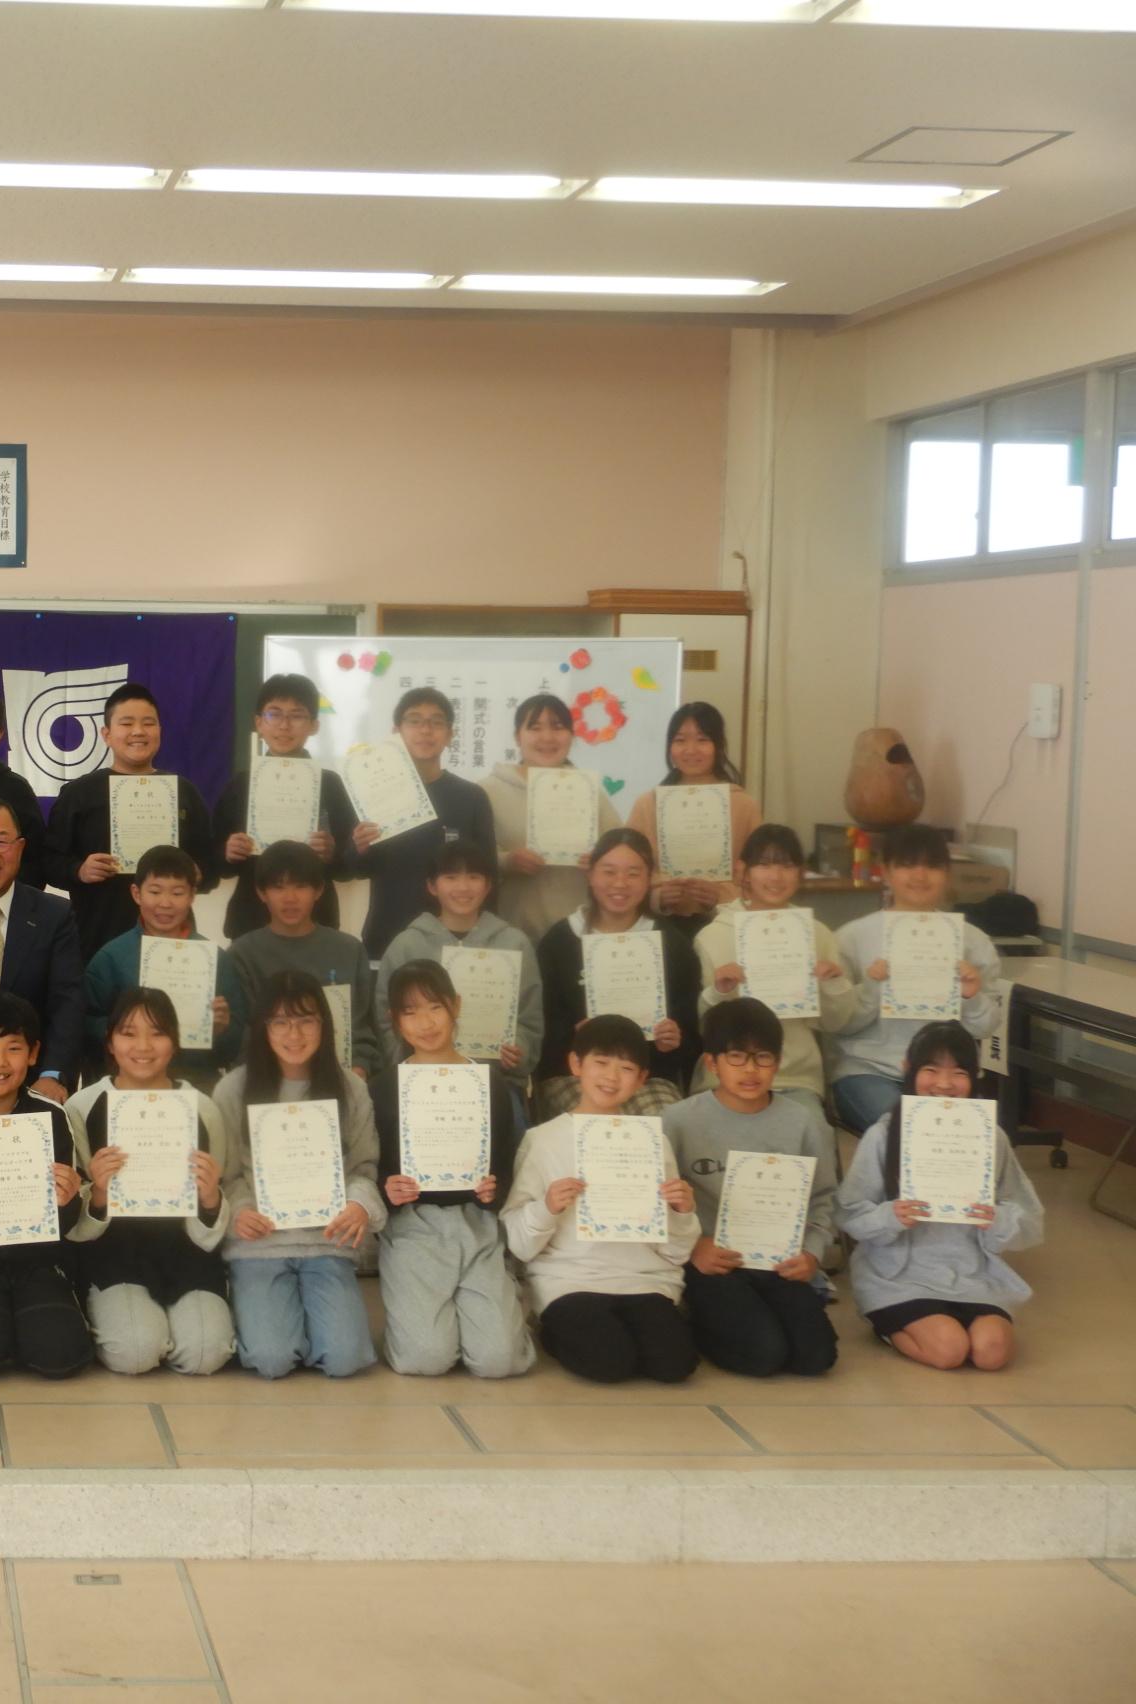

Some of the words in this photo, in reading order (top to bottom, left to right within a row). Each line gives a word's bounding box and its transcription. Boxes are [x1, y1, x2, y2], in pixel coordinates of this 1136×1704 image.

[0, 470, 12, 541] 学校教育目標
